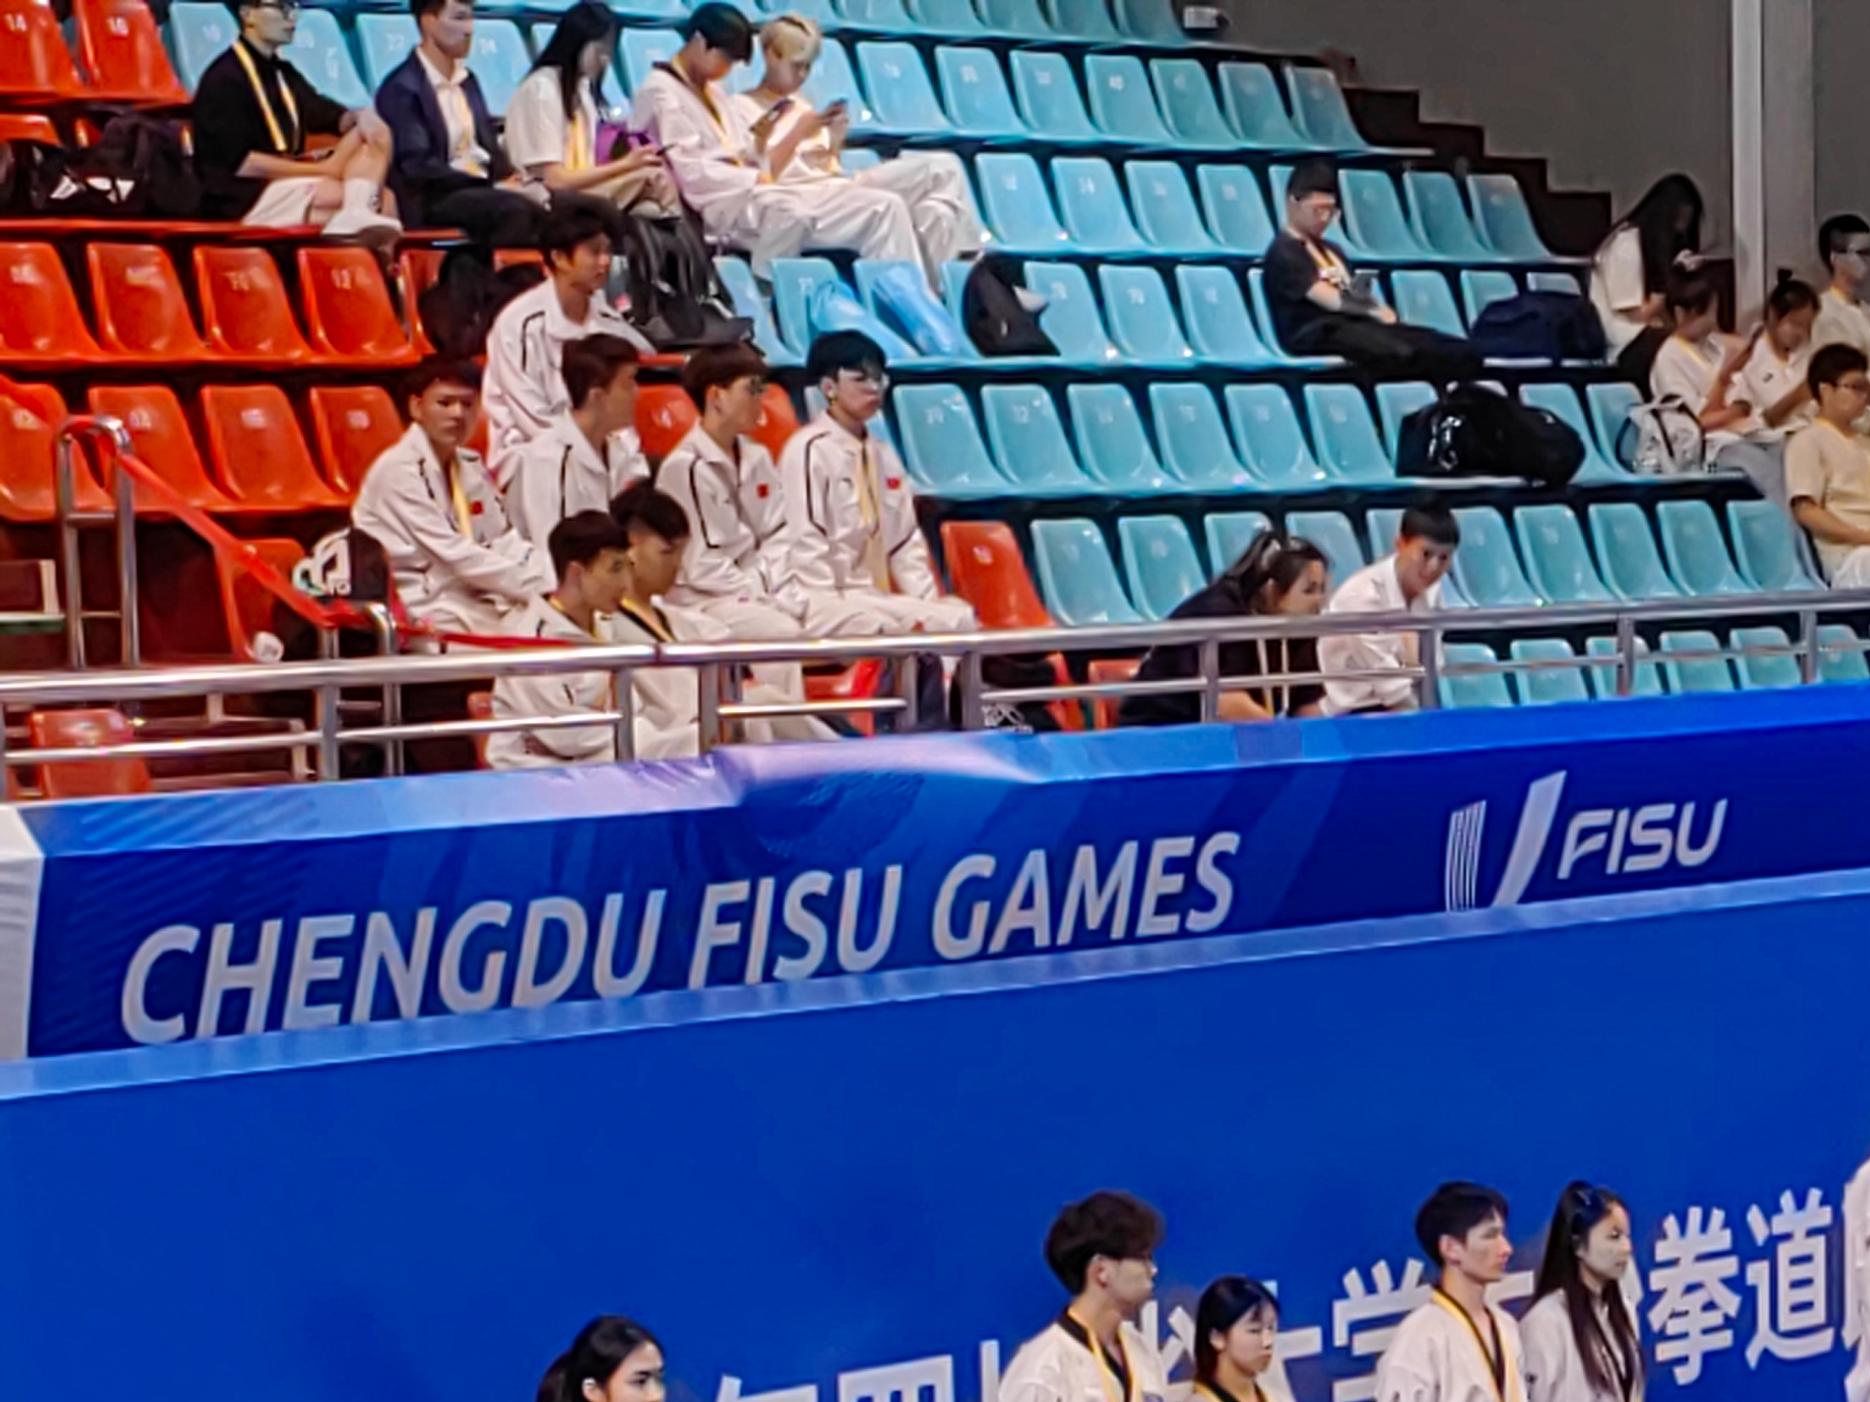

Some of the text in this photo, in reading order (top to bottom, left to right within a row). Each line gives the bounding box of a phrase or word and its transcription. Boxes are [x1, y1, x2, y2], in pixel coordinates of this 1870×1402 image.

[1556, 797, 1728, 880] FISU
[119, 831, 1241, 1044] CHENGDU FISU GAMES
